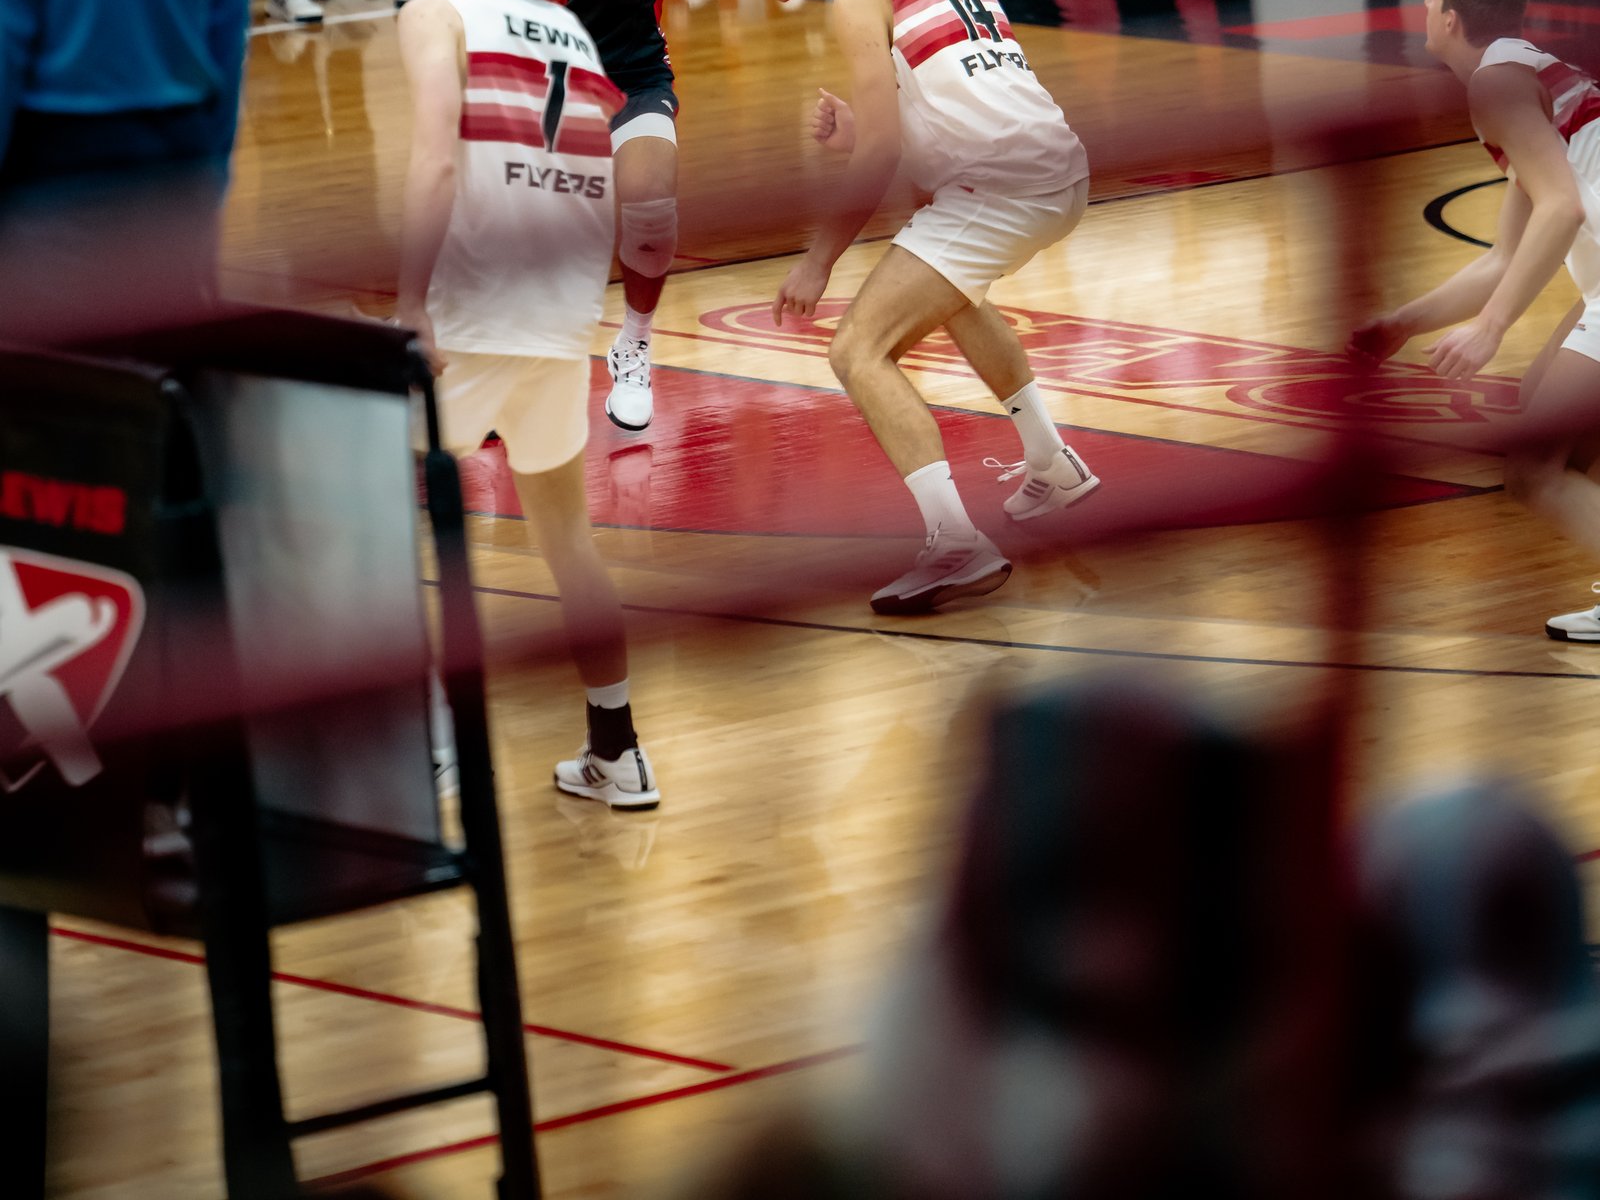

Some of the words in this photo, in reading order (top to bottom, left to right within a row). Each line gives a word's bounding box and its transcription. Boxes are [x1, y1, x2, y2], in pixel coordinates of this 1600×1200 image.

[960, 49, 1033, 77] FLYR
[543, 60, 569, 154] 1
[0, 469, 127, 535] EWIS
